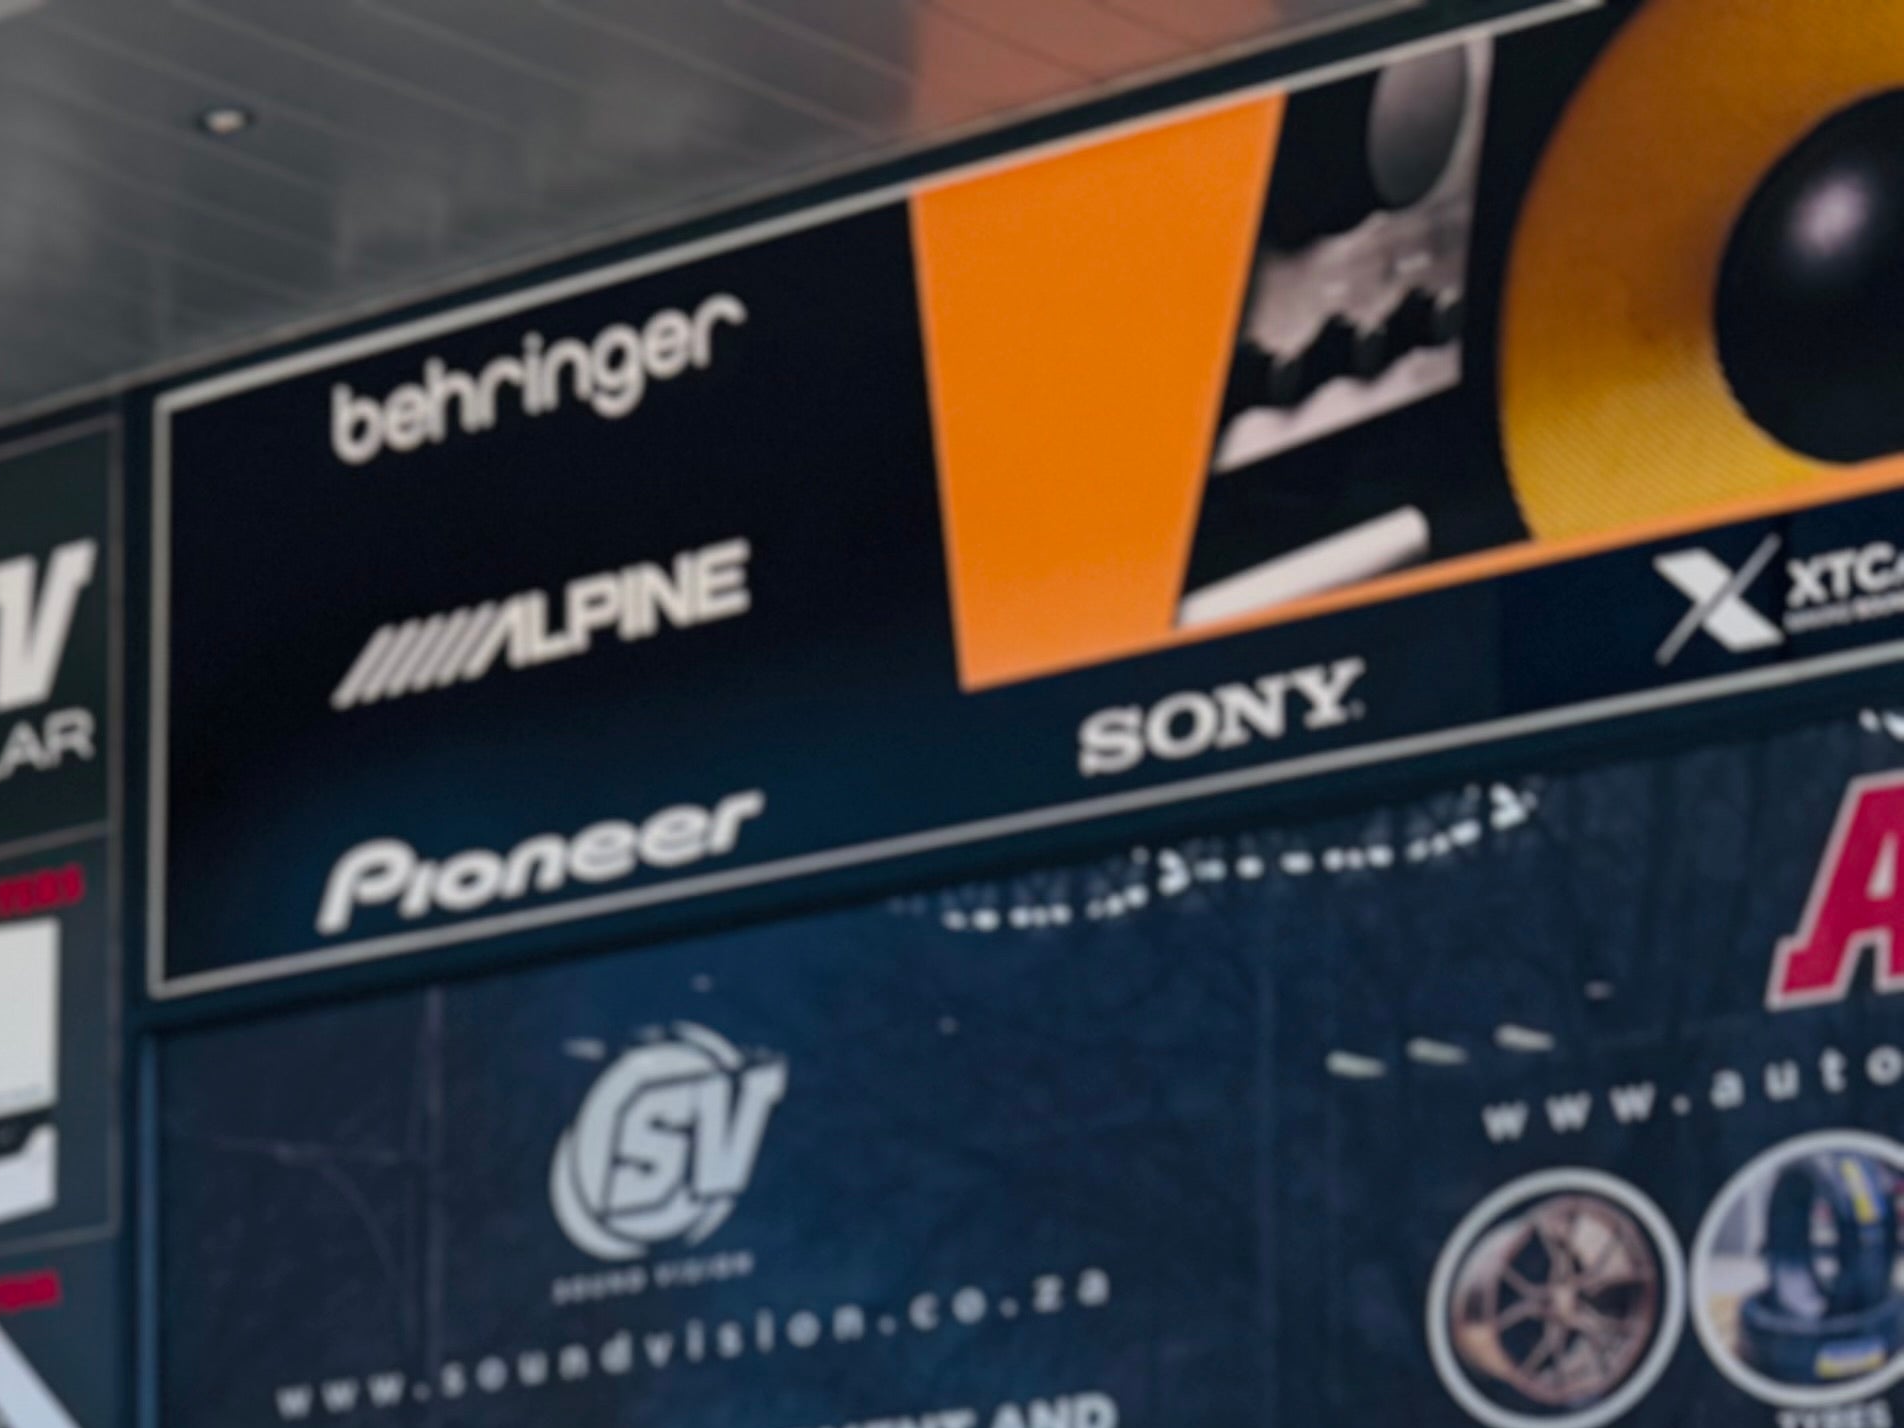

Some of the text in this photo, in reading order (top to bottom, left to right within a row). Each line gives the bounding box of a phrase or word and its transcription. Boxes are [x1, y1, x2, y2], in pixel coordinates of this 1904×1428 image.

[330, 292, 749, 465] behringer
[330, 537, 752, 711] ALPINE
[1786, 540, 1904, 610] XTC
[1077, 656, 1365, 777] SONY
[314, 788, 768, 935] Pioneer
[275, 1265, 1112, 1420] www.soundvision.co.za
